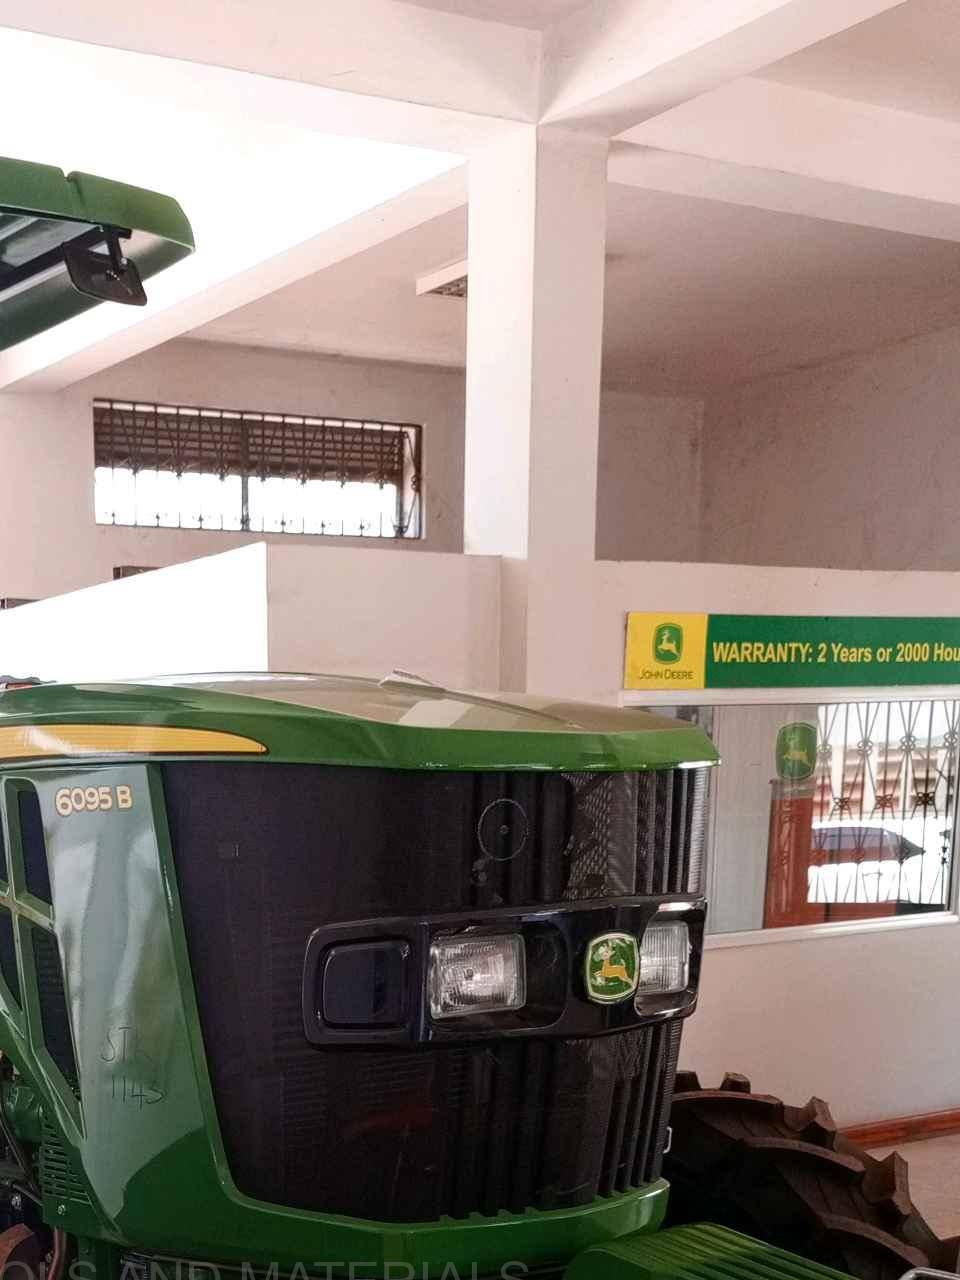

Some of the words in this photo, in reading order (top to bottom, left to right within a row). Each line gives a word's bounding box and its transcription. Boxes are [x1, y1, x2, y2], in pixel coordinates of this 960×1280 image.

[713, 642, 813, 663] WARRANTY:
[817, 642, 827, 663] 2
[831, 642, 872, 663] Years
[876, 647, 892, 663] or
[895, 642, 929, 663] 2000
[640, 669, 663, 680] JOHN
[664, 669, 694, 680] DEERE
[55, 786, 113, 817] 6095
[116, 785, 133, 809] B
